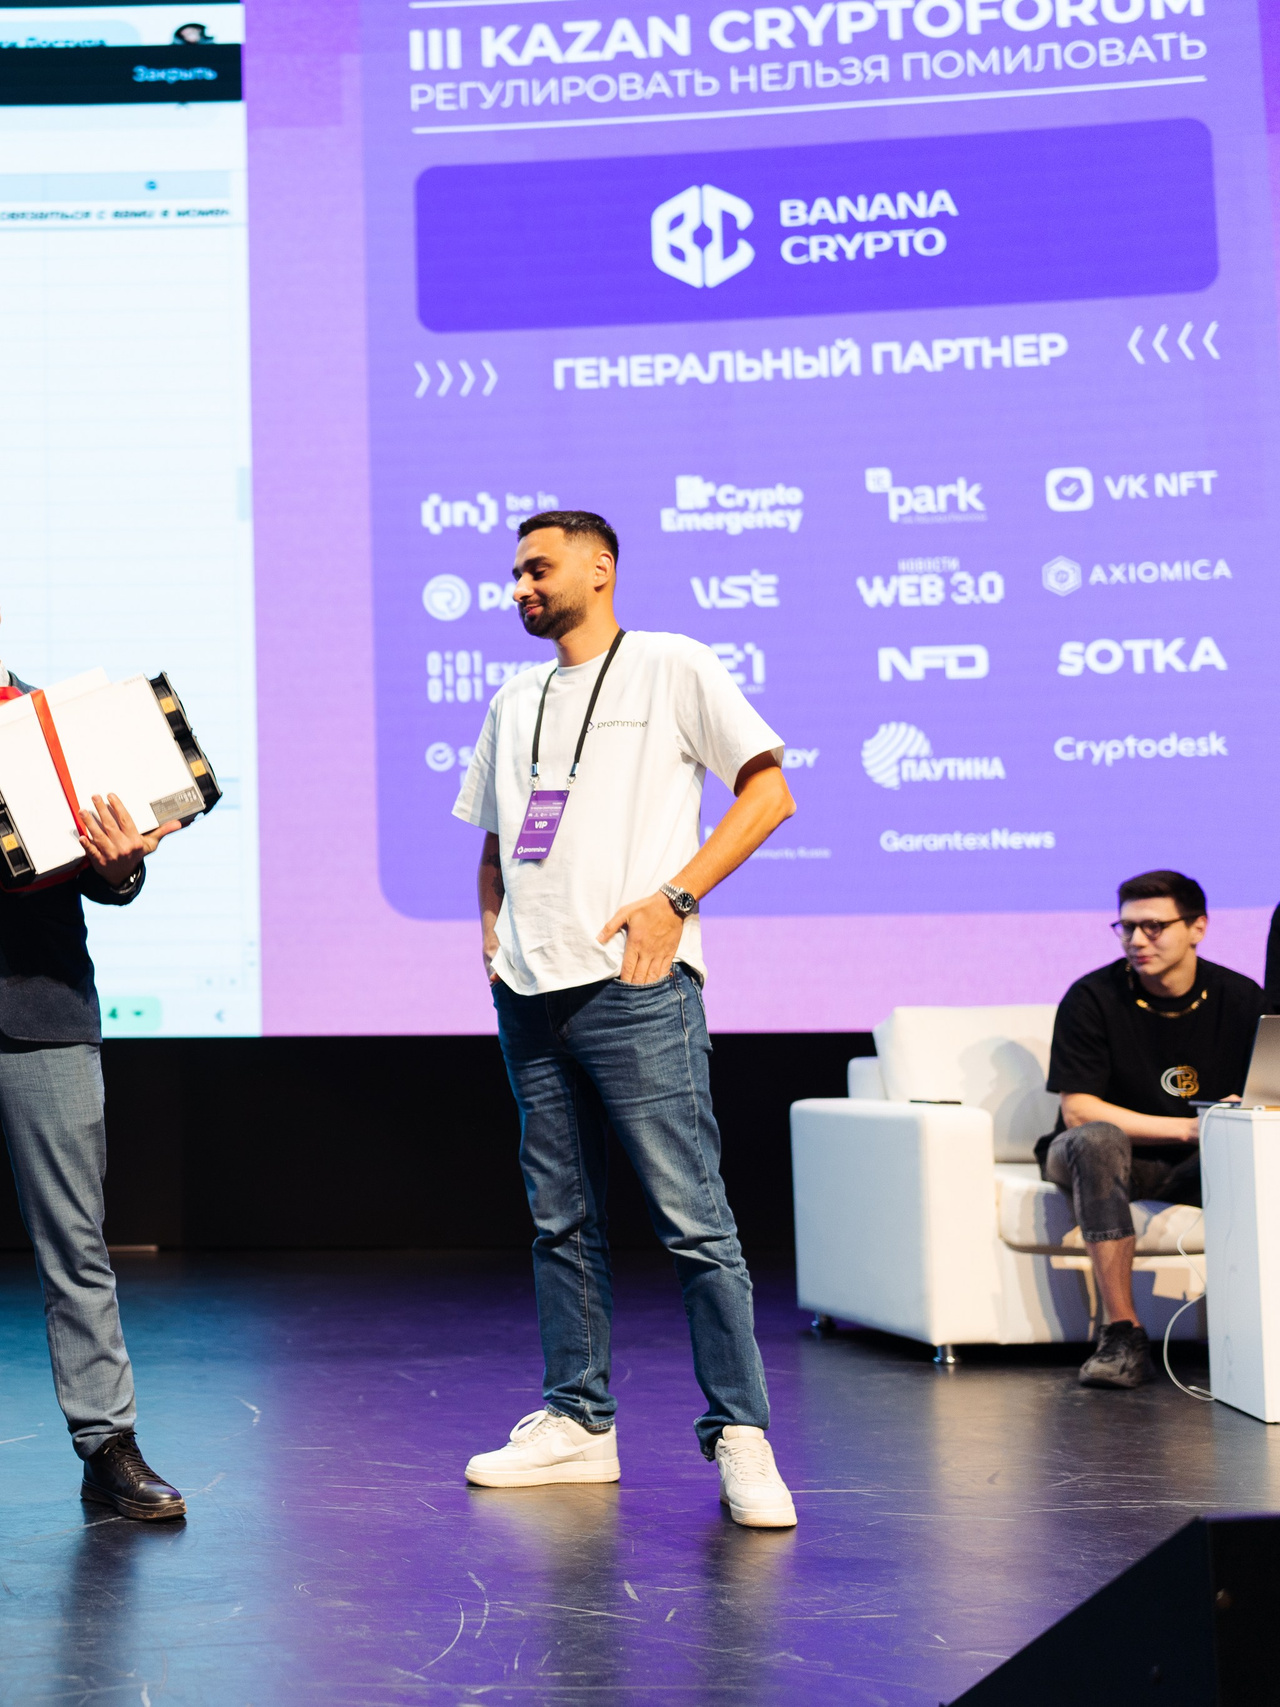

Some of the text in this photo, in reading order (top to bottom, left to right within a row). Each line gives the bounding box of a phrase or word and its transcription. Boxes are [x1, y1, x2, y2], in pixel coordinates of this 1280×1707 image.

[409, 28, 462, 71] III
[479, 14, 692, 68] KAZAN
[408, 31, 1209, 113] РЕГУЛИРОВАТЬ НЕЛЬЗЯ ПОМИЛОВАТЬ
[778, 189, 960, 228] BANANA
[778, 226, 948, 266] CRYPTO
[553, 331, 1069, 391] ГЕНЕРАЛЬНЫЙ ПАРТНЕР
[716, 483, 804, 511] Crypto
[886, 475, 987, 524] park
[1104, 469, 1219, 500] VK NFT
[660, 507, 804, 536] Emergency
[856, 570, 1005, 608] WEB 3.0
[1089, 559, 1232, 585] AXIOMICA
[878, 645, 989, 681] NFD
[1058, 637, 1227, 676] SOTKA
[597, 719, 649, 730] prommine
[1052, 729, 1230, 768] Cryptodesk
[900, 755, 1008, 783] ПАУТИНА
[534, 820, 549, 829] VIP
[878, 826, 1057, 853] GarantexNews
